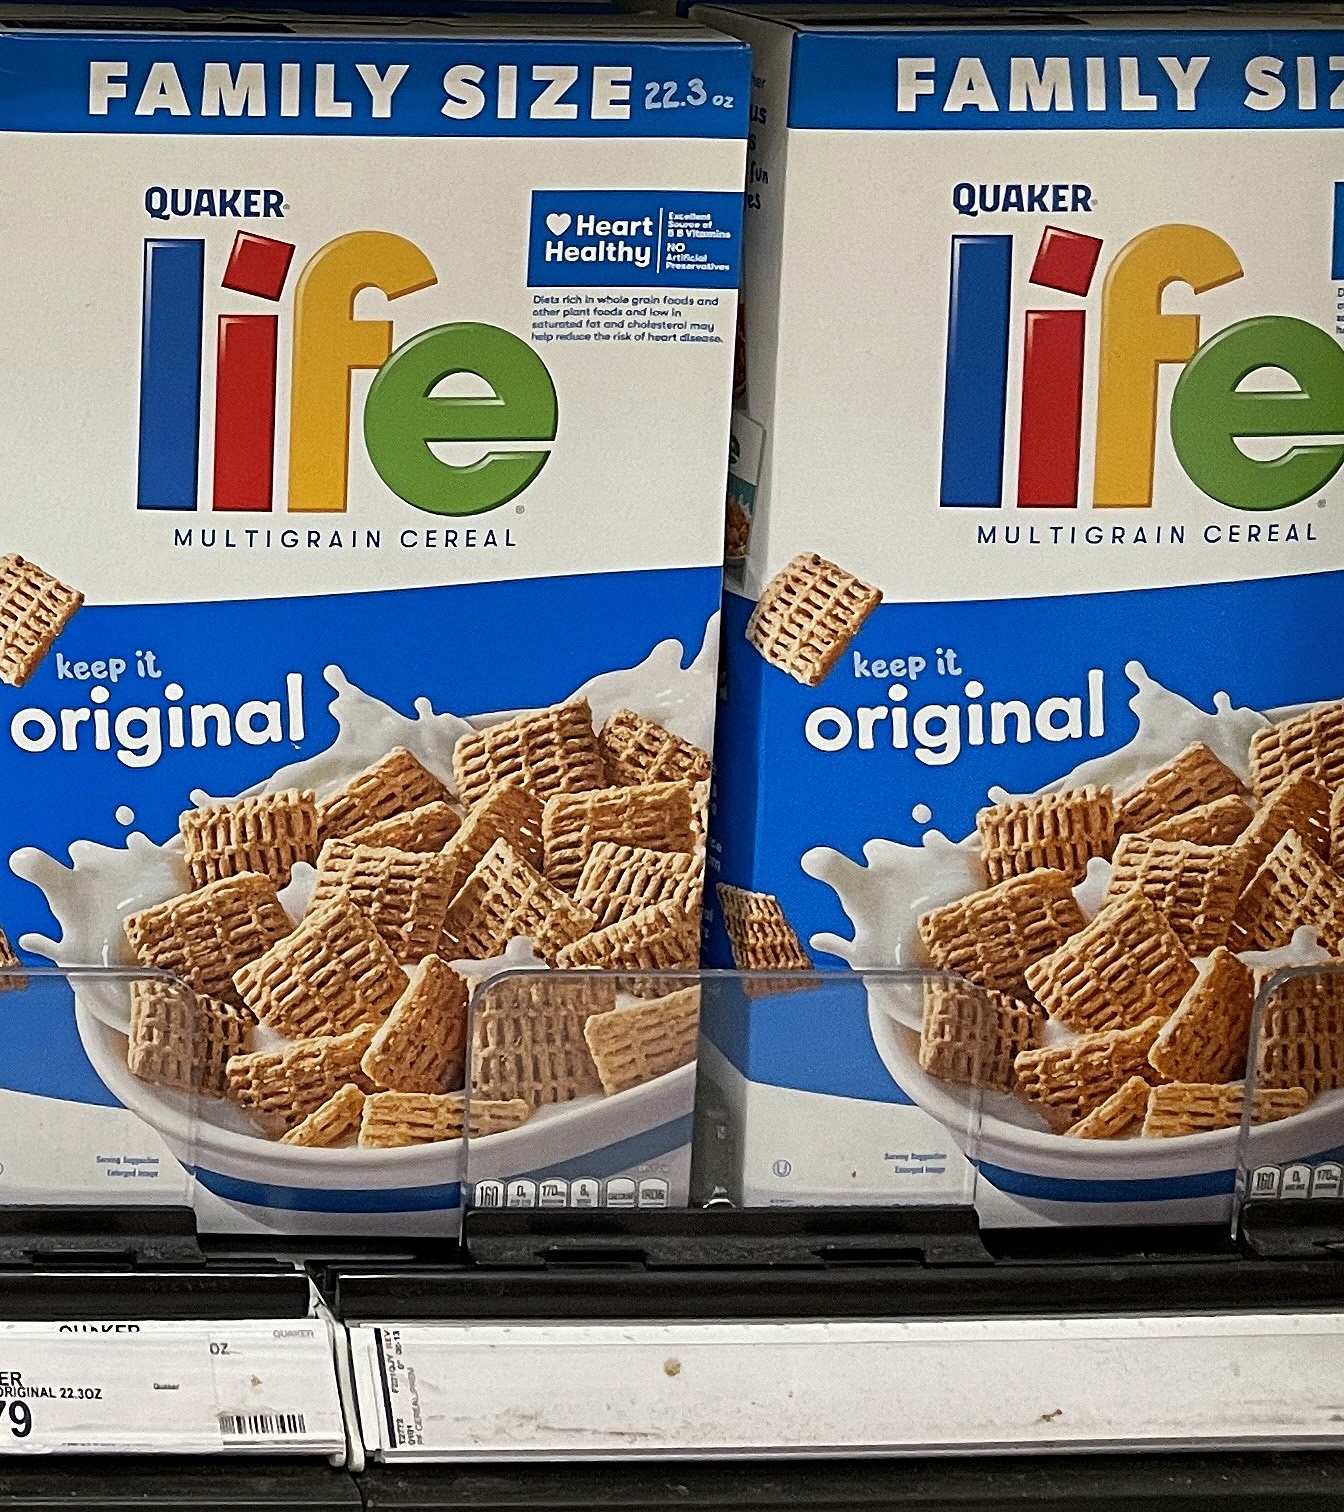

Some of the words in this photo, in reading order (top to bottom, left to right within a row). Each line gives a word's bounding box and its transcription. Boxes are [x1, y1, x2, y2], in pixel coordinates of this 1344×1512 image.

[88, 61, 409, 119] FAMILY
[441, 64, 634, 120] SIZE
[644, 80, 708, 110] 22.3
[712, 94, 733, 107] oz
[897, 56, 1210, 112] FAMILY
[145, 187, 285, 220] QUAKER
[952, 183, 1093, 215] QUAKER
[577, 215, 653, 237] Heart
[544, 241, 652, 268] Healthy
[137, 231, 559, 517] life
[940, 224, 1344, 511] life
[175, 530, 380, 548] MULTIGRAIN
[400, 529, 516, 548] CEREAL
[978, 525, 1186, 545] MULTIGRAIN
[1204, 523, 1318, 542] CEREAL
[56, 653, 126, 682] keep
[135, 650, 161, 678] it
[10, 674, 304, 768] original
[805, 670, 1103, 766] original
